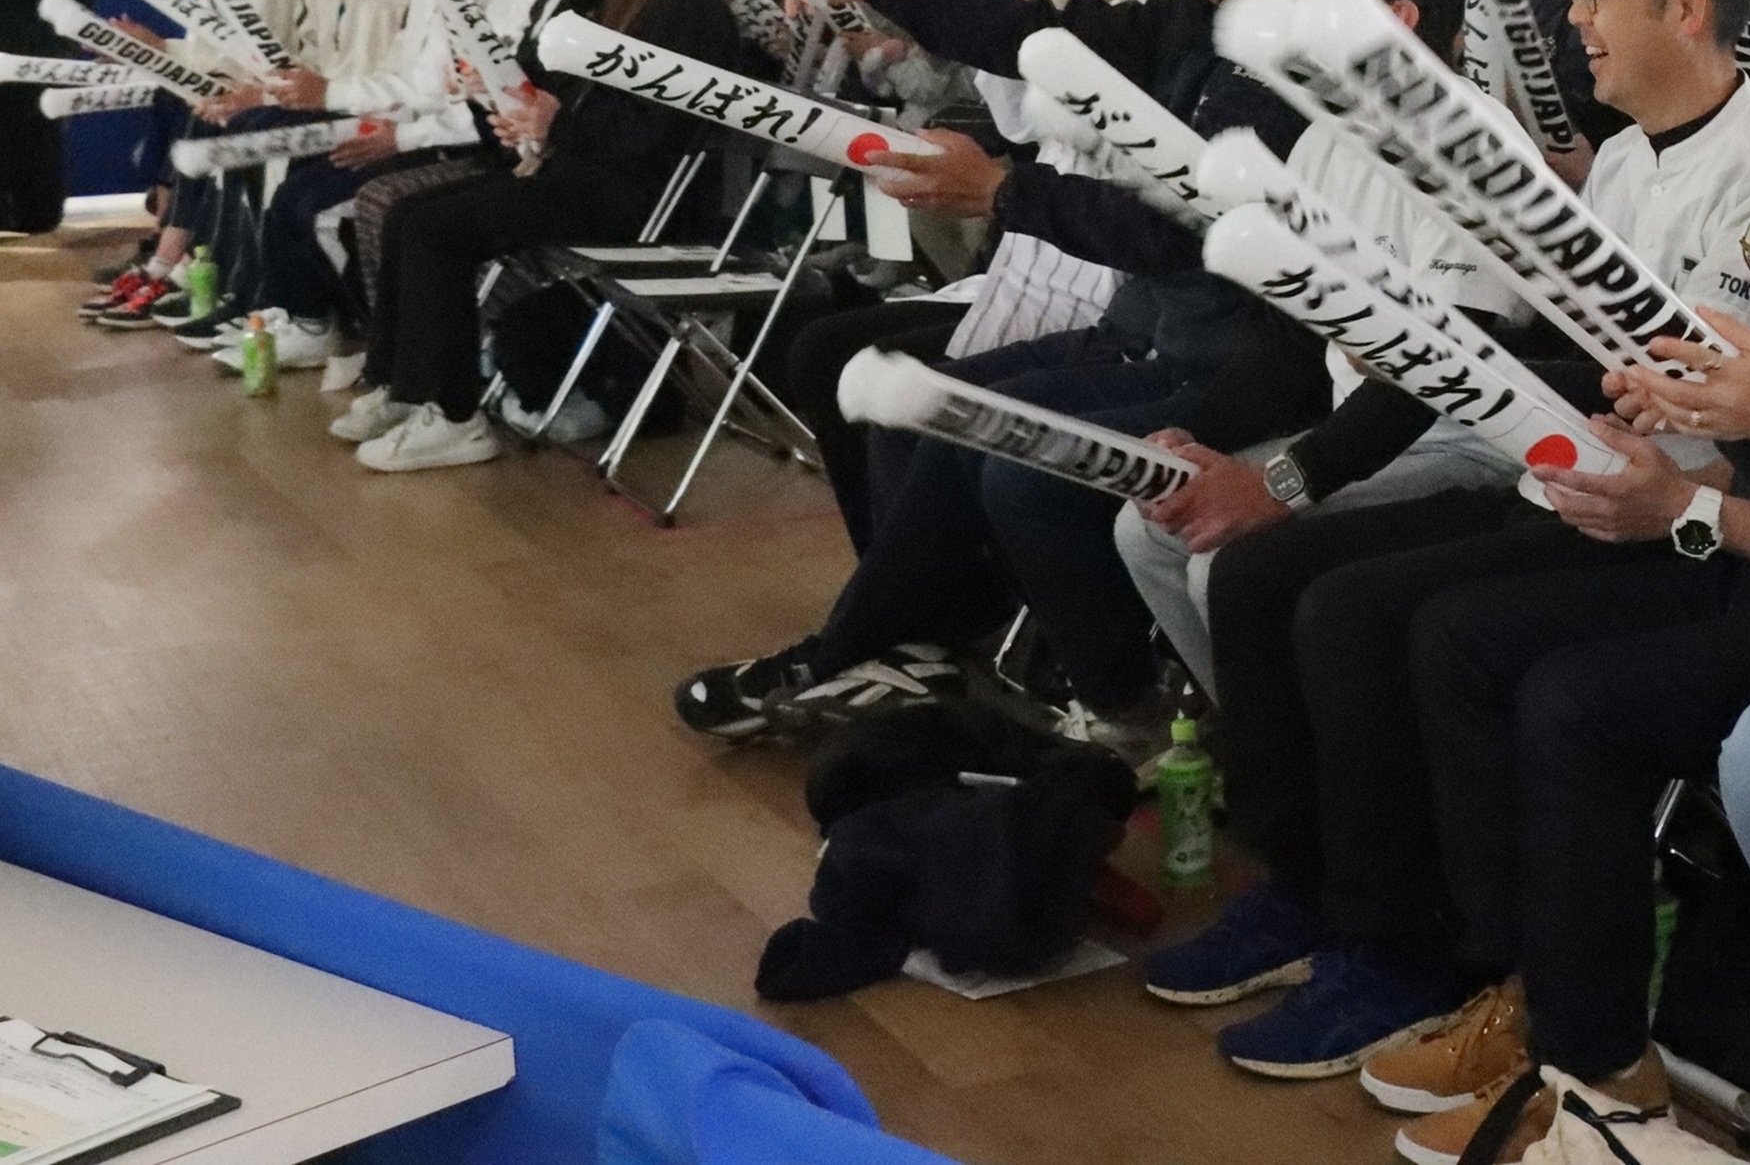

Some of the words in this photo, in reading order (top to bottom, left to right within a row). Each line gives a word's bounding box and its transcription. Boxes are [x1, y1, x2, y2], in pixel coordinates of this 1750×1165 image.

[585, 42, 822, 144] がんばれ!
[1261, 263, 1518, 427] がんばれ!
